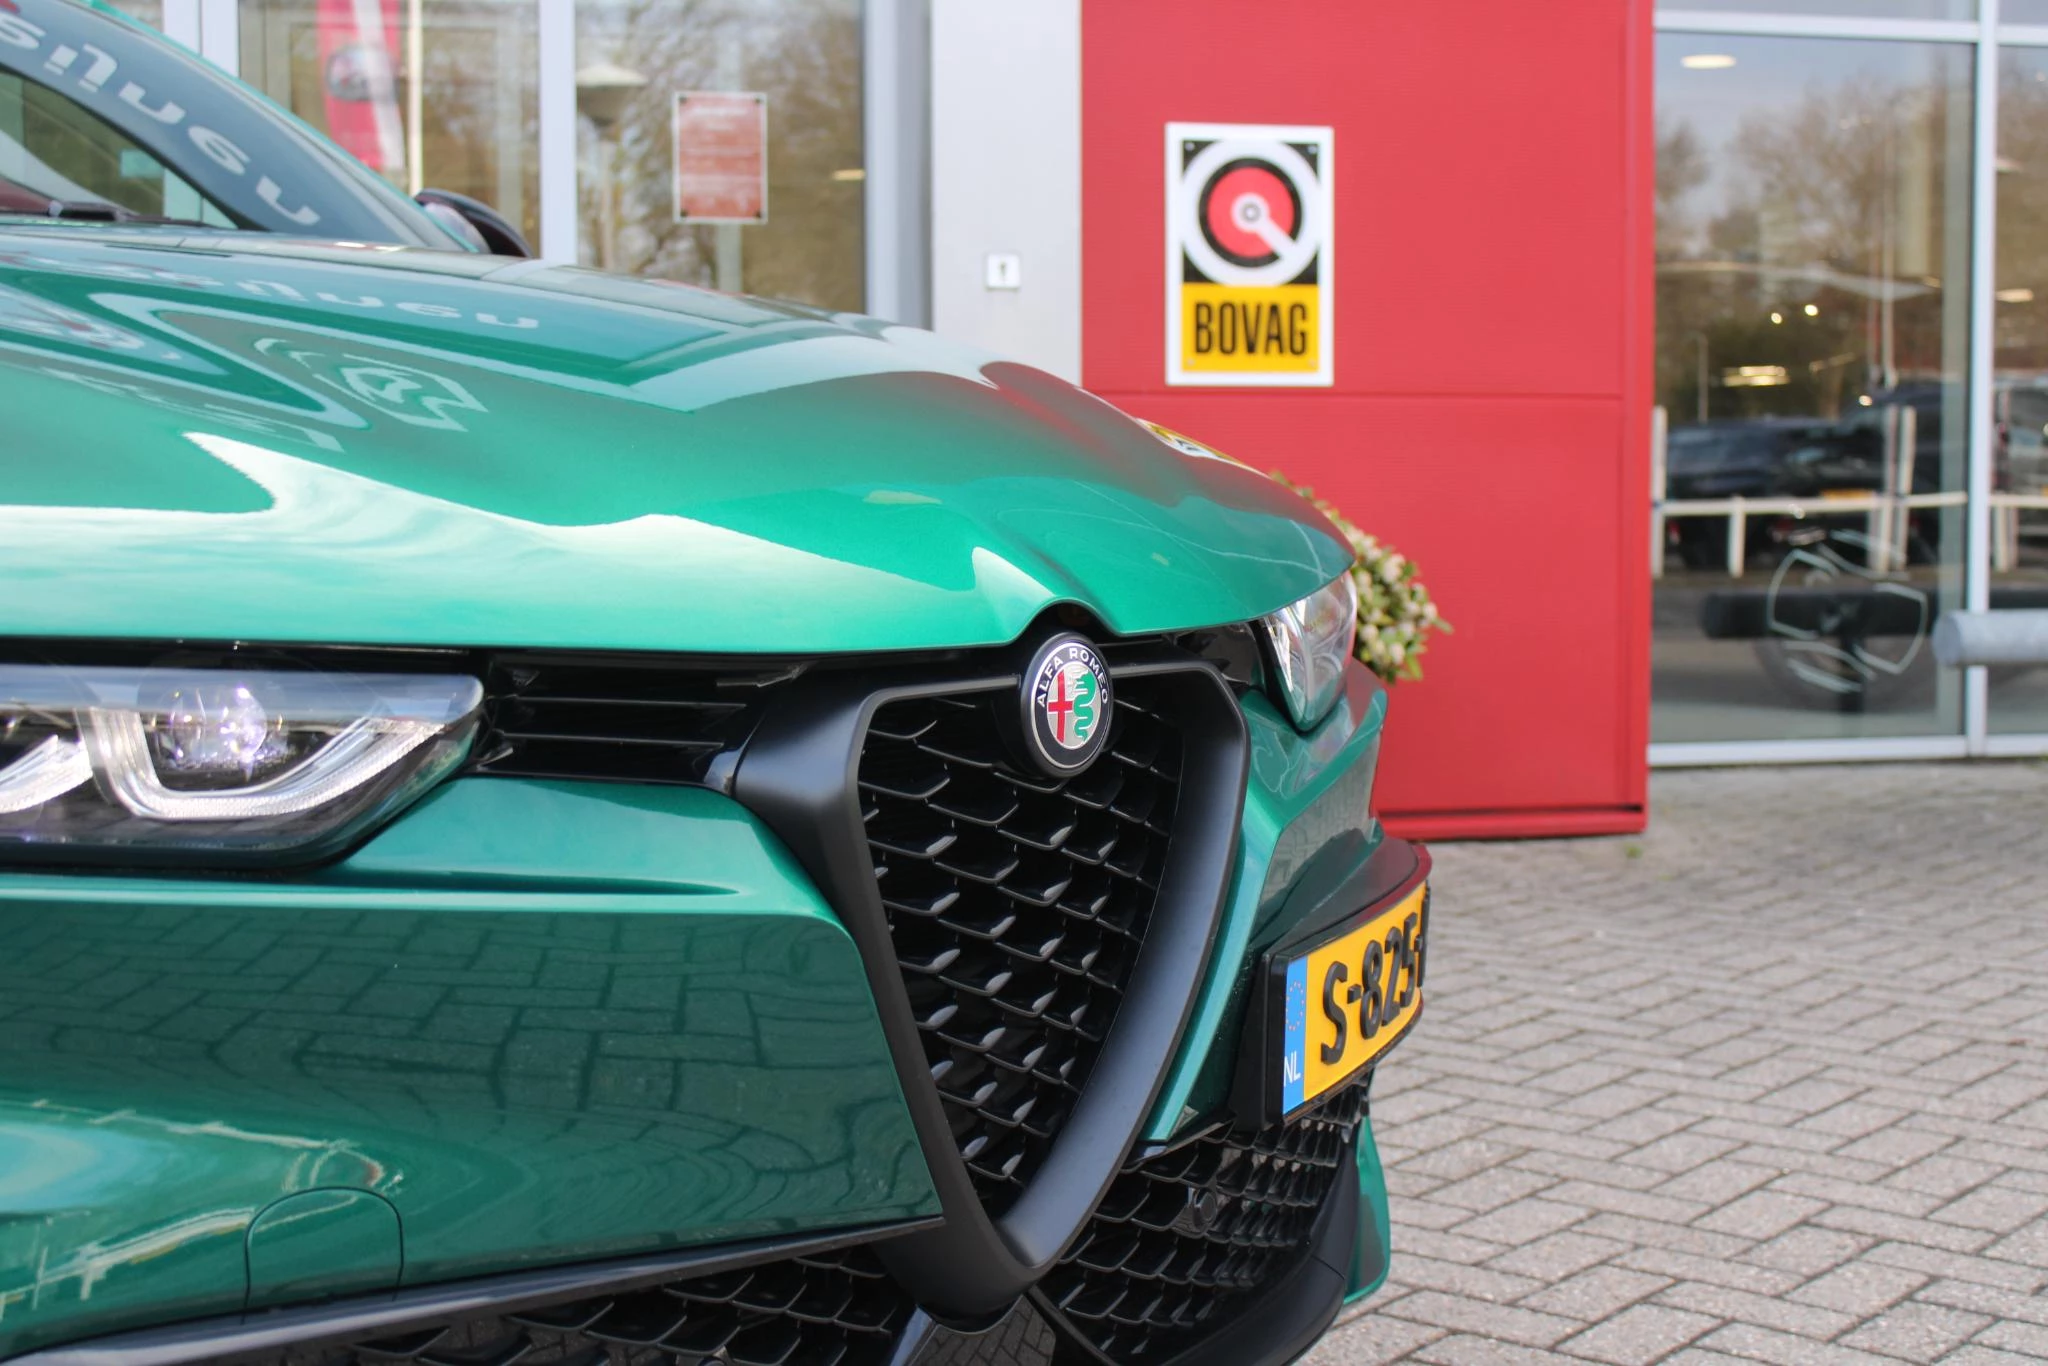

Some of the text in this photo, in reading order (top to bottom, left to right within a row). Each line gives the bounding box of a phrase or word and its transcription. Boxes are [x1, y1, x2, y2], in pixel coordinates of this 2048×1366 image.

[1195, 301, 1307, 356] BOVAG
[1037, 647, 1109, 708] ALFA ROMEO
[1283, 1051, 1301, 1087] NL
